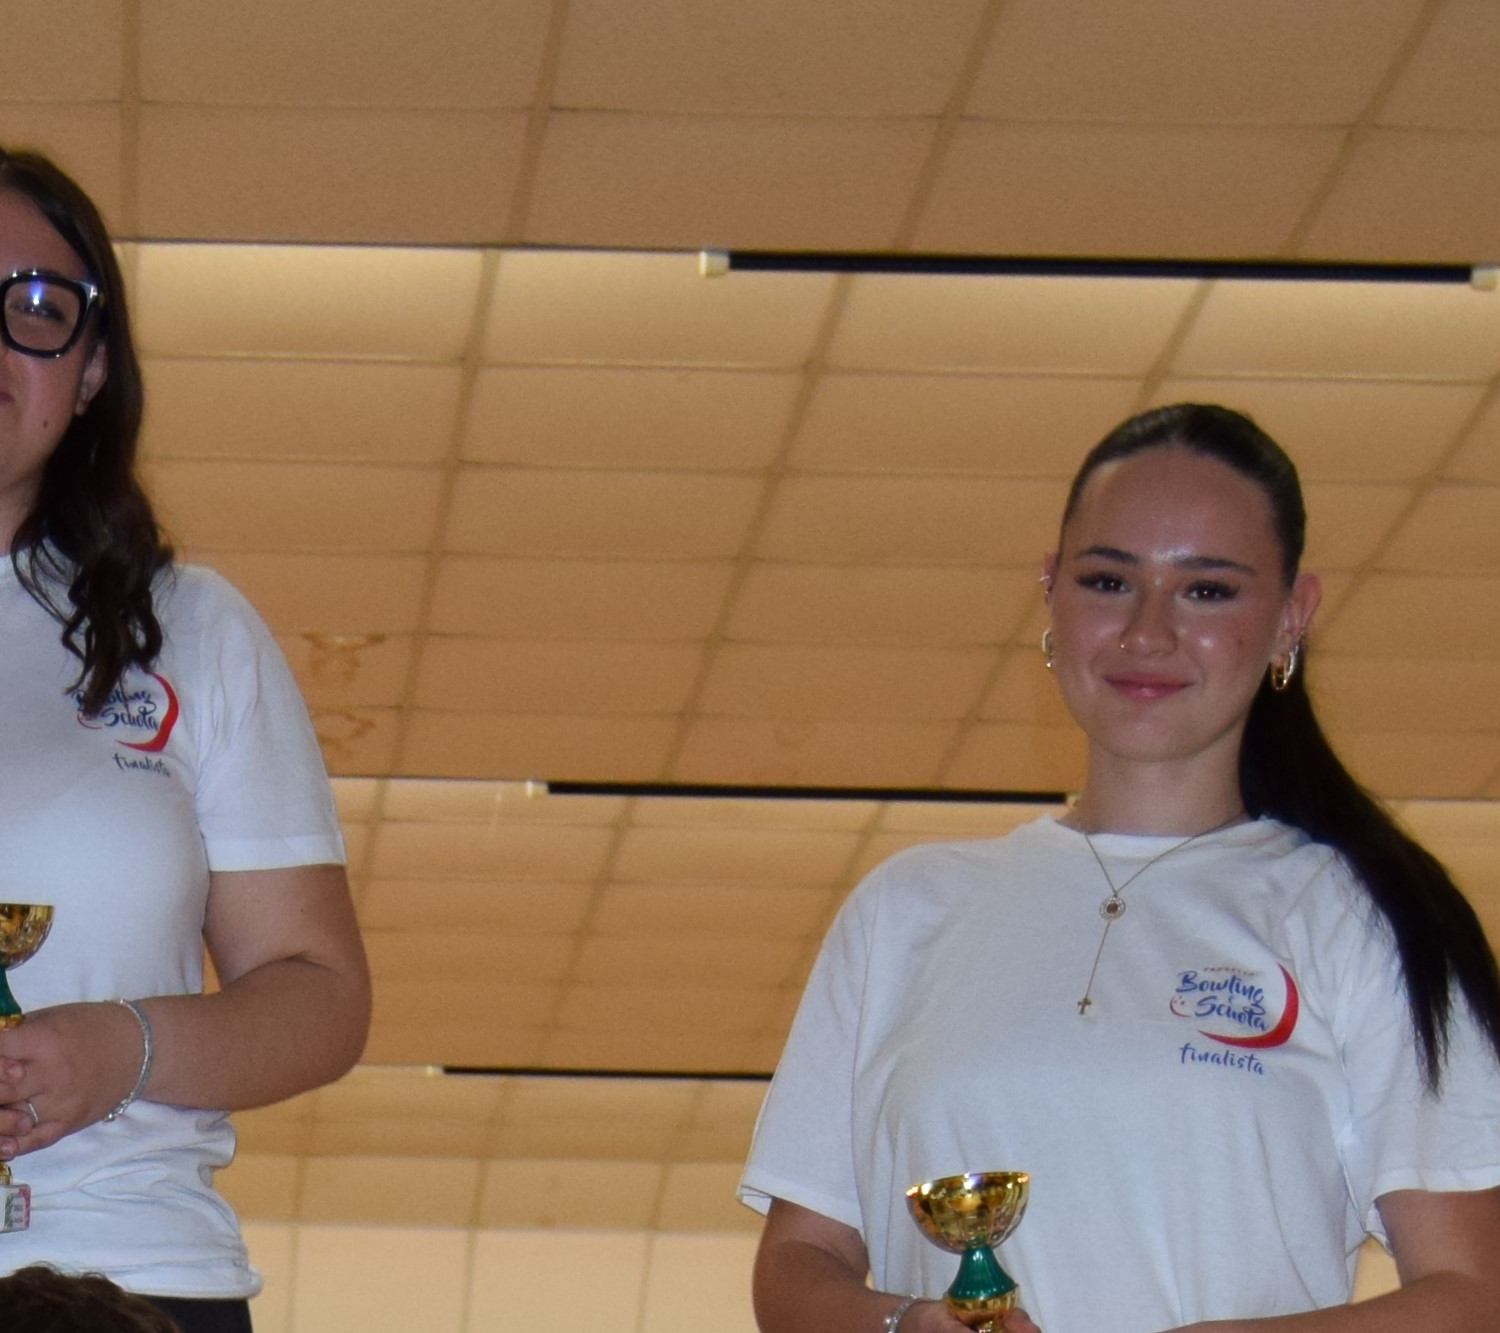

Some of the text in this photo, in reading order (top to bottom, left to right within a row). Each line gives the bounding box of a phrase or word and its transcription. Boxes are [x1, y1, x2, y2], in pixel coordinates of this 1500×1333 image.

[1175, 971, 1266, 1014] Bowling
[1195, 996, 1268, 1031] Scuola
[1180, 1043, 1266, 1076] finalista
